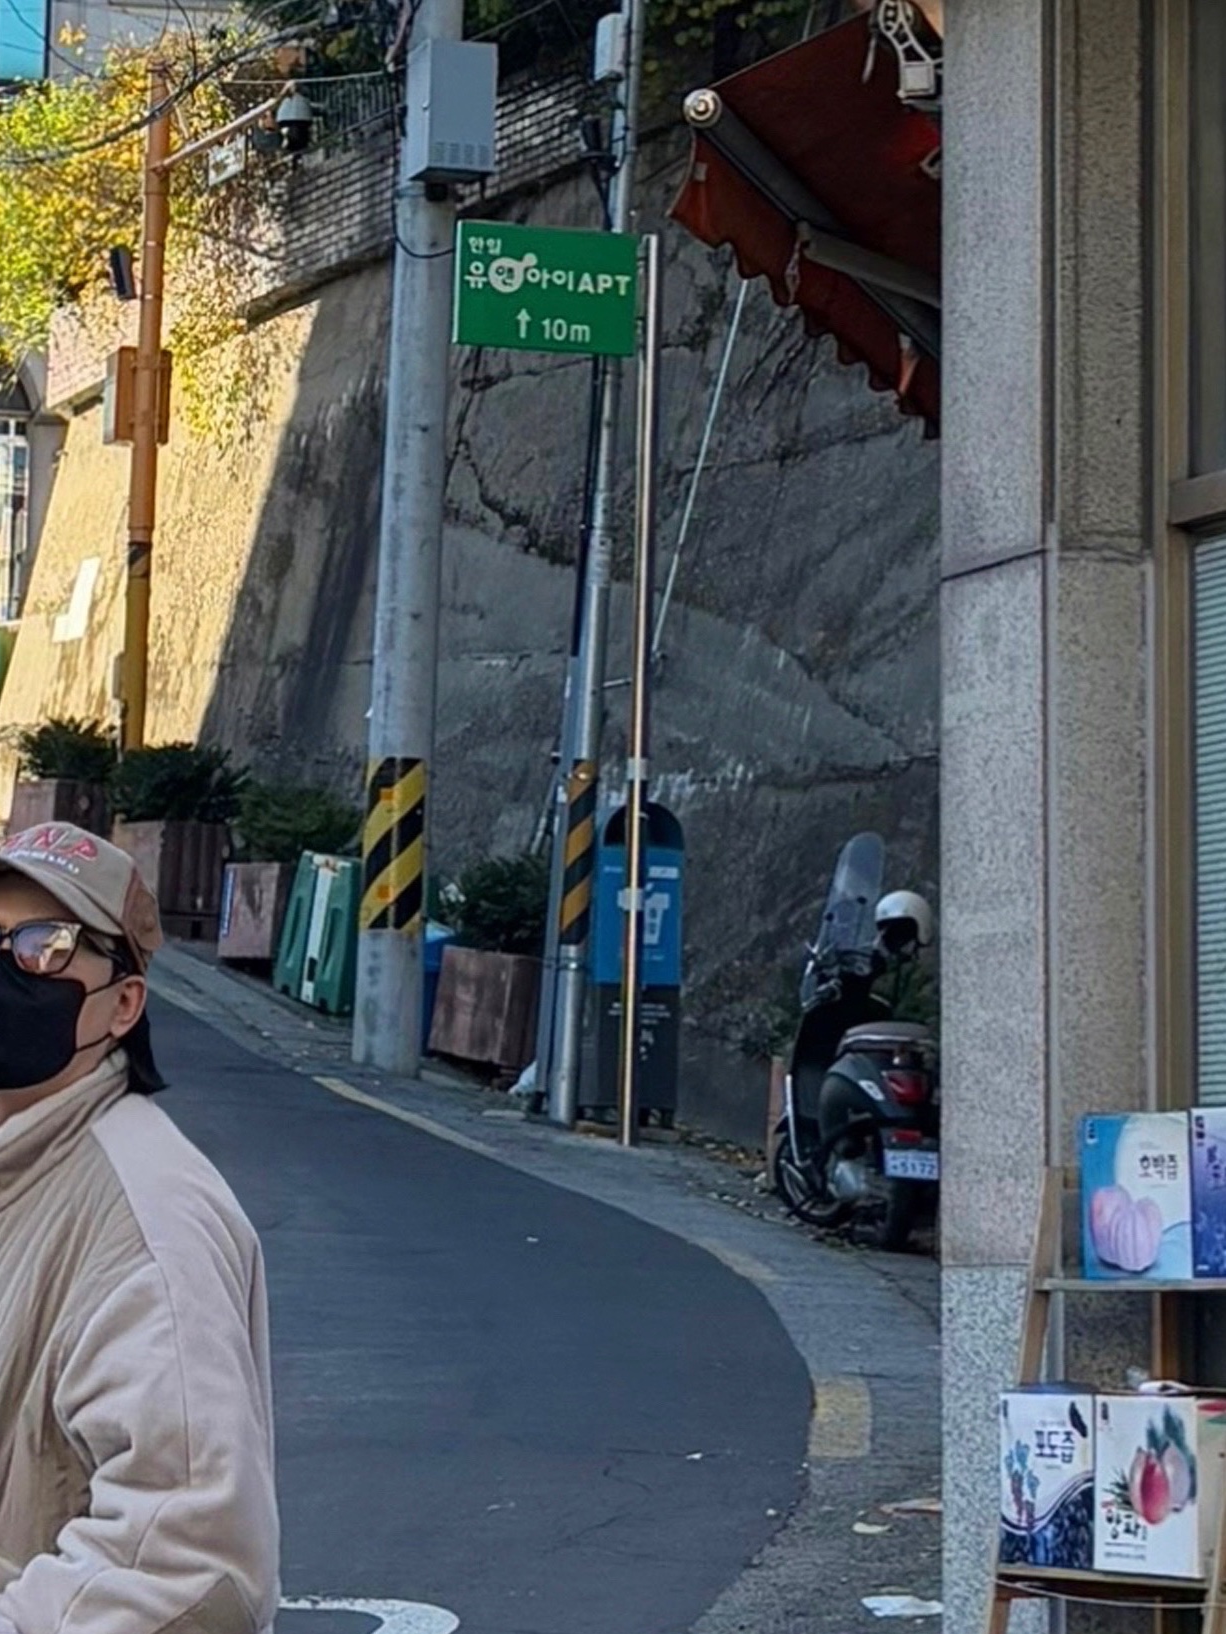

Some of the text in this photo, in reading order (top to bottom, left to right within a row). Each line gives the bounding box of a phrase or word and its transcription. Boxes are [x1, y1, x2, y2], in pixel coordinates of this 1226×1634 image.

[468, 236, 502, 255] 한일
[541, 318, 591, 342] 10m
[1035, 1430, 1076, 1464] 포도즙
